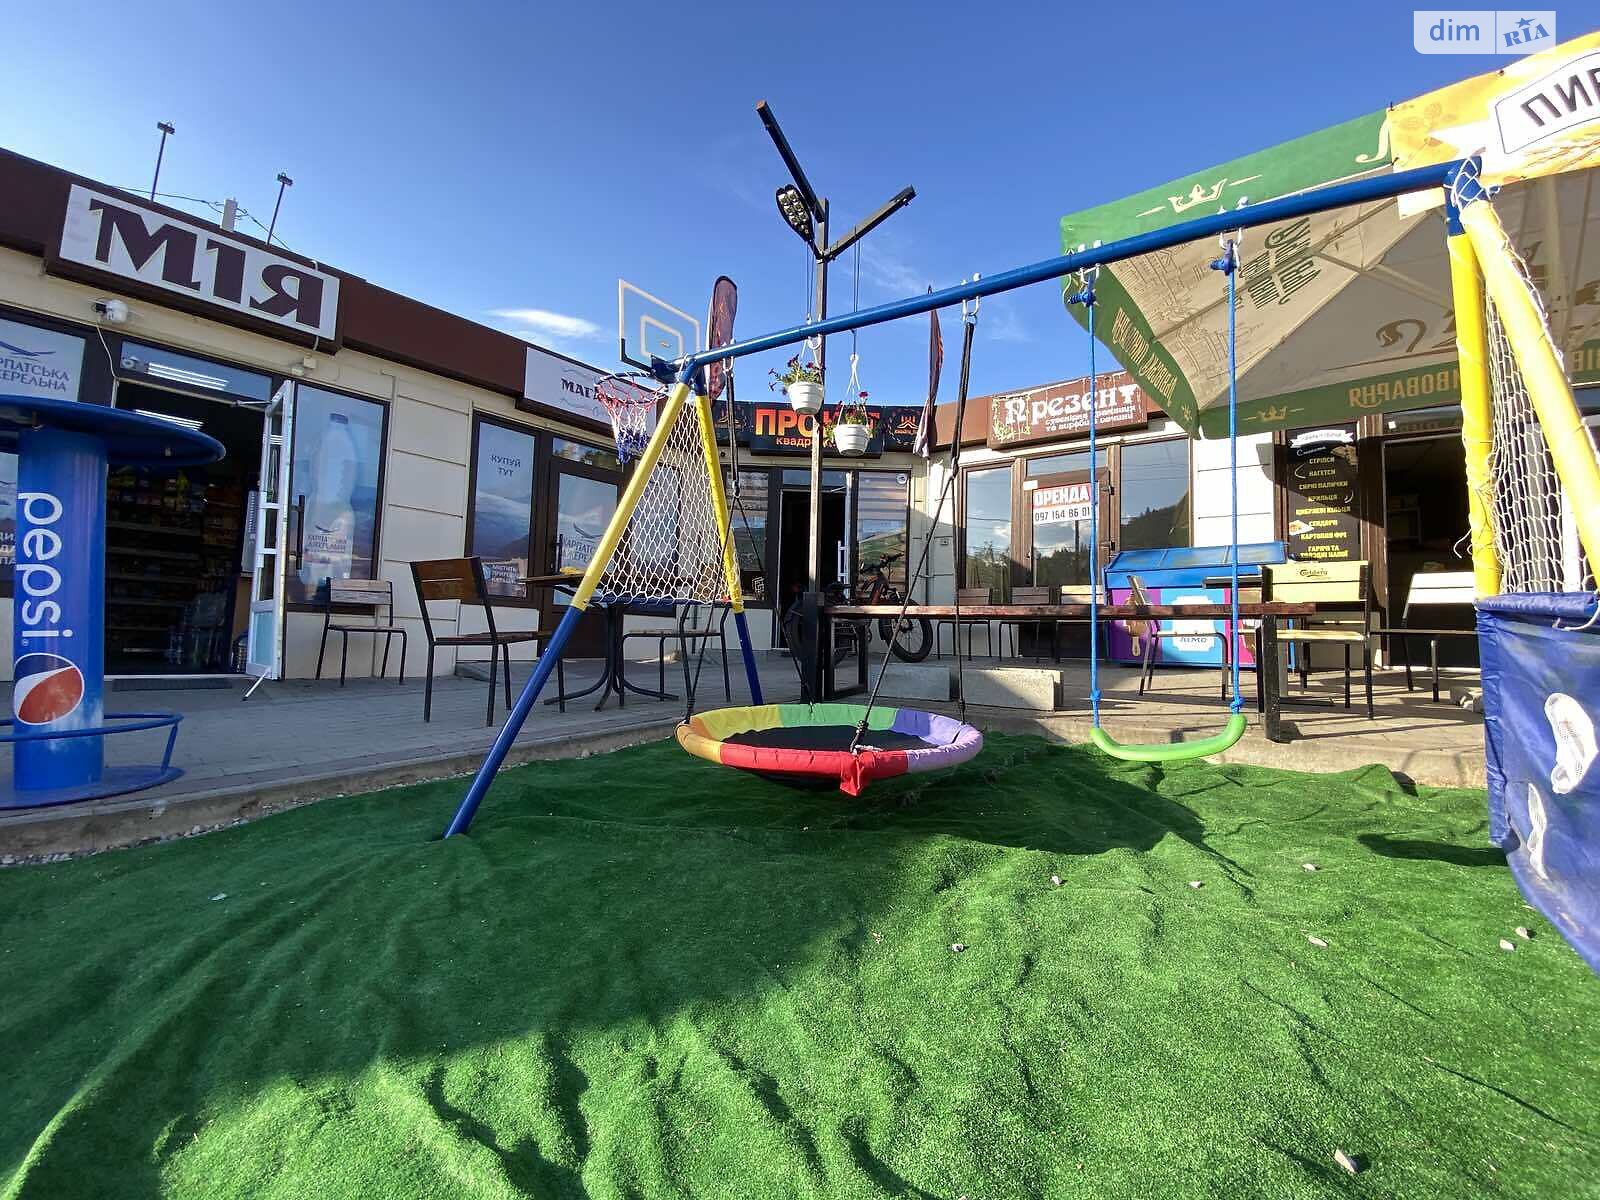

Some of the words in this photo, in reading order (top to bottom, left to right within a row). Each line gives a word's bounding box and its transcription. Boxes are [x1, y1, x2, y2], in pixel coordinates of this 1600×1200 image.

[0, 369, 67, 393] ЕРЕЛЬНА
[498, 467, 513, 477] ТУТ
[1033, 484, 1090, 506] ОРЕНДА
[1034, 511, 1049, 522] 097
[16, 492, 73, 638] pepsi
